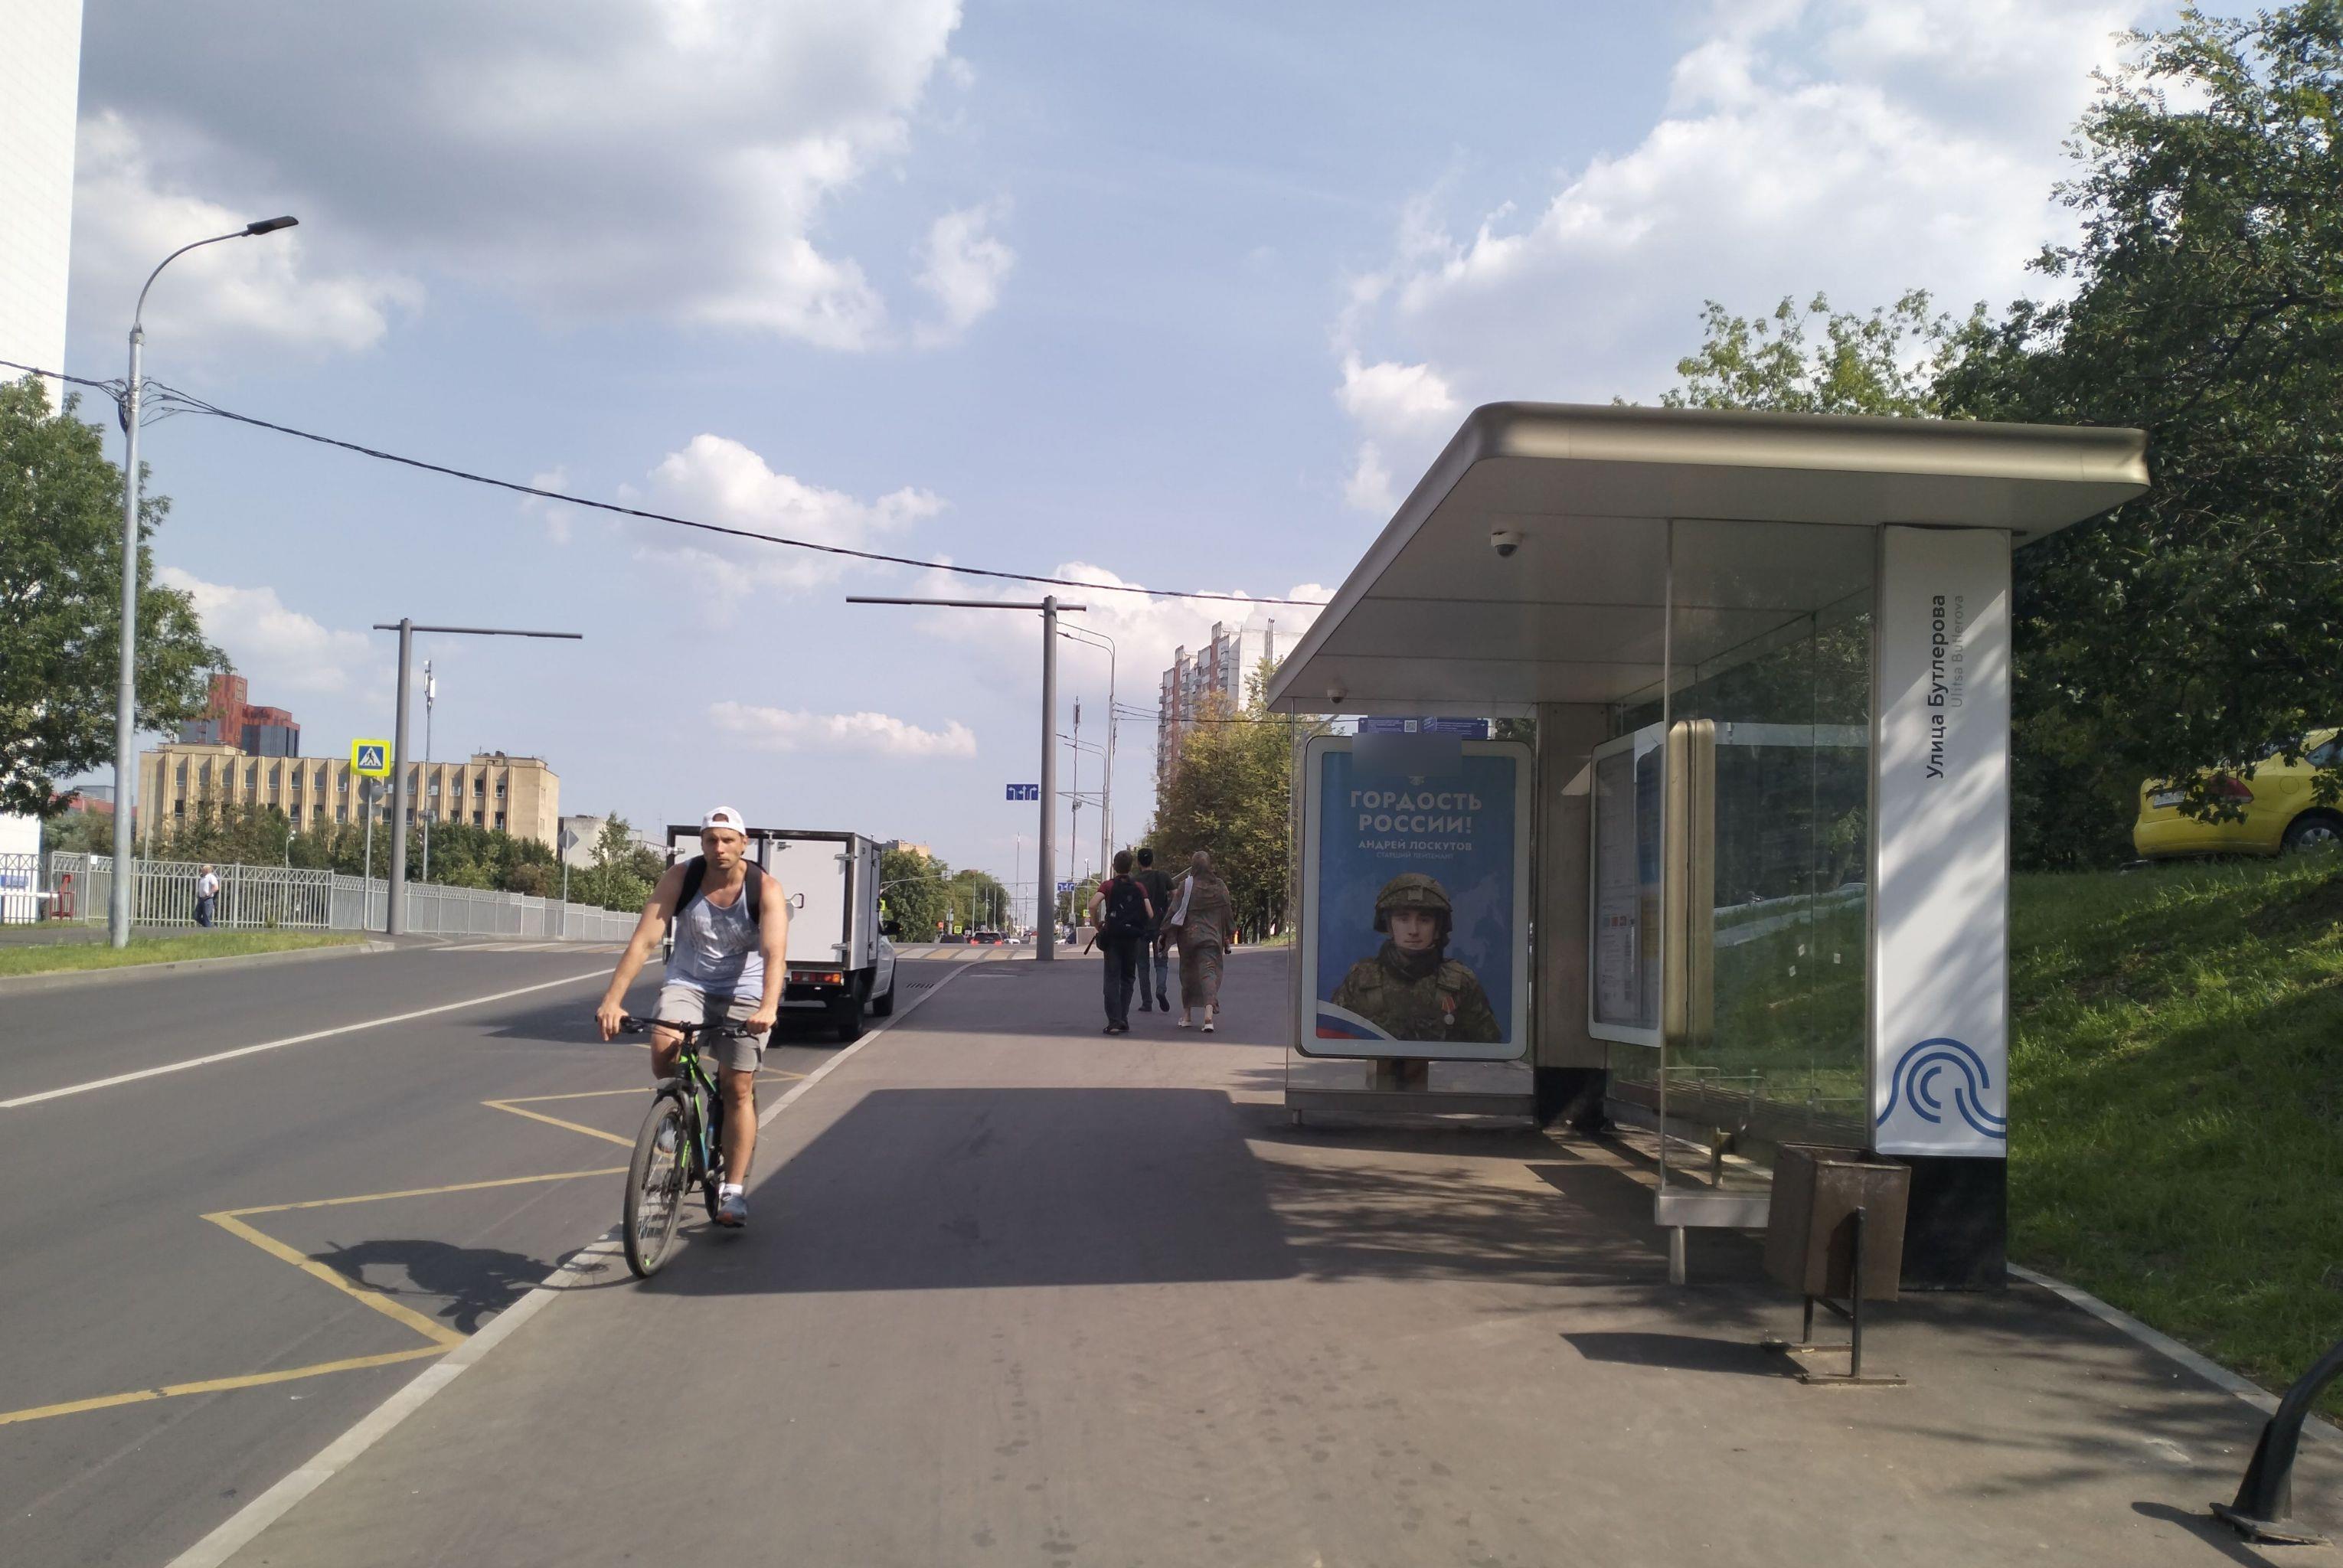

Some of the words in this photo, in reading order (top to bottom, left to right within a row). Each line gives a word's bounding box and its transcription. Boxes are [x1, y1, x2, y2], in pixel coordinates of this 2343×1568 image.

[1952, 595, 1964, 662] Butlerova
[1927, 595, 1949, 707] Бутлерова
[1951, 668, 1963, 707] Ulitsa
[1926, 714, 1946, 779] Улица
[1350, 790, 1482, 812] ГОРДОСТЬ
[1359, 814, 1472, 834] РОССИИ!
[1358, 839, 1406, 851] АНДРЕЙ
[1409, 841, 1472, 851] ЛОСКУТОВ
